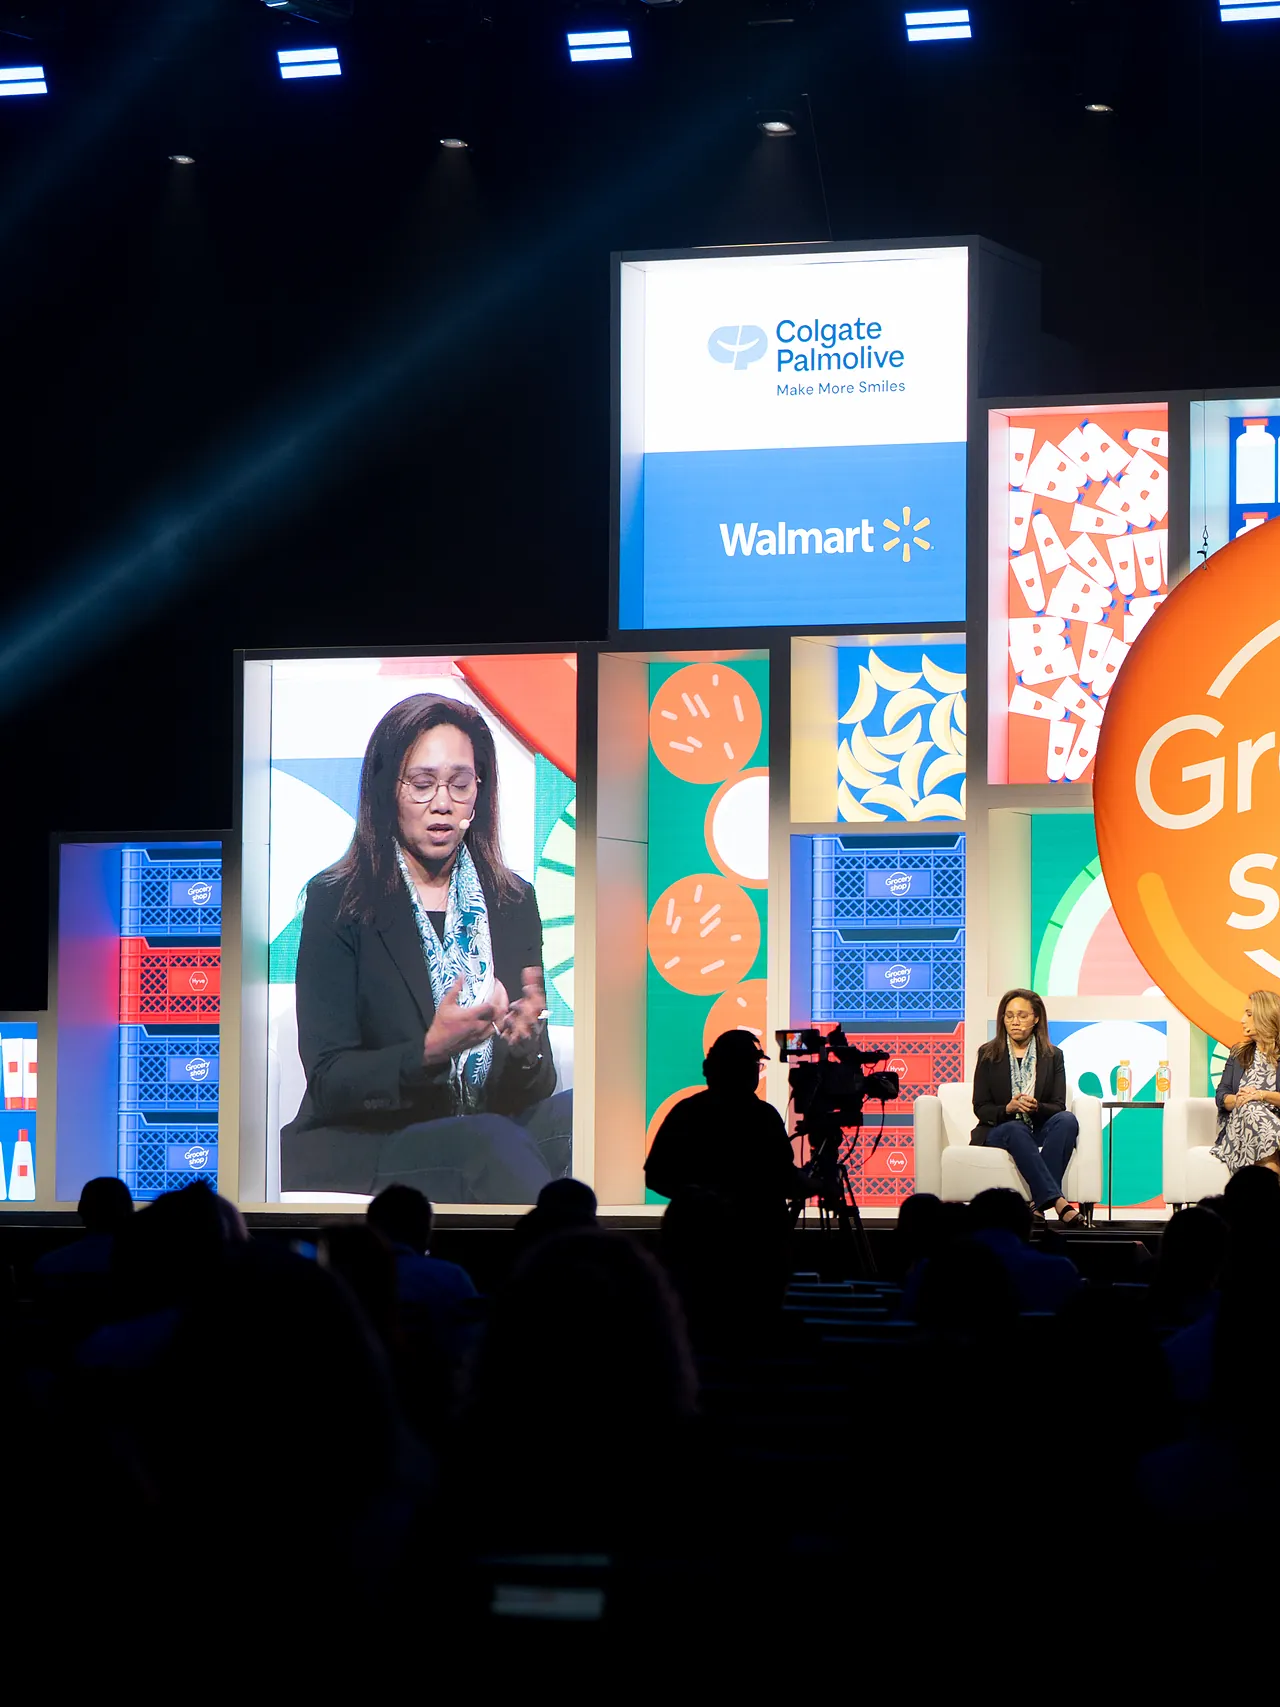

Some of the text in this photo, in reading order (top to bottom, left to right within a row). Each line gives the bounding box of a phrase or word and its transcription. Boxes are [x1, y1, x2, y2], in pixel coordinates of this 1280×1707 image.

[775, 317, 882, 348] Colgate
[777, 346, 905, 373] Palmolive
[776, 379, 906, 396] Make More Smiles
[719, 519, 875, 557] Walmart
[885, 876, 912, 886] Grocery
[188, 886, 213, 896] Grocery
[890, 883, 907, 892] shop
[192, 893, 207, 901] shop
[884, 968, 911, 979] Grocery
[889, 976, 906, 985] shop
[185, 1061, 210, 1072] Grocery
[190, 1069, 206, 1077] shop
[184, 1150, 209, 1160] Grocery
[188, 1157, 205, 1165] shop
[889, 1158, 905, 1167] Hyve
